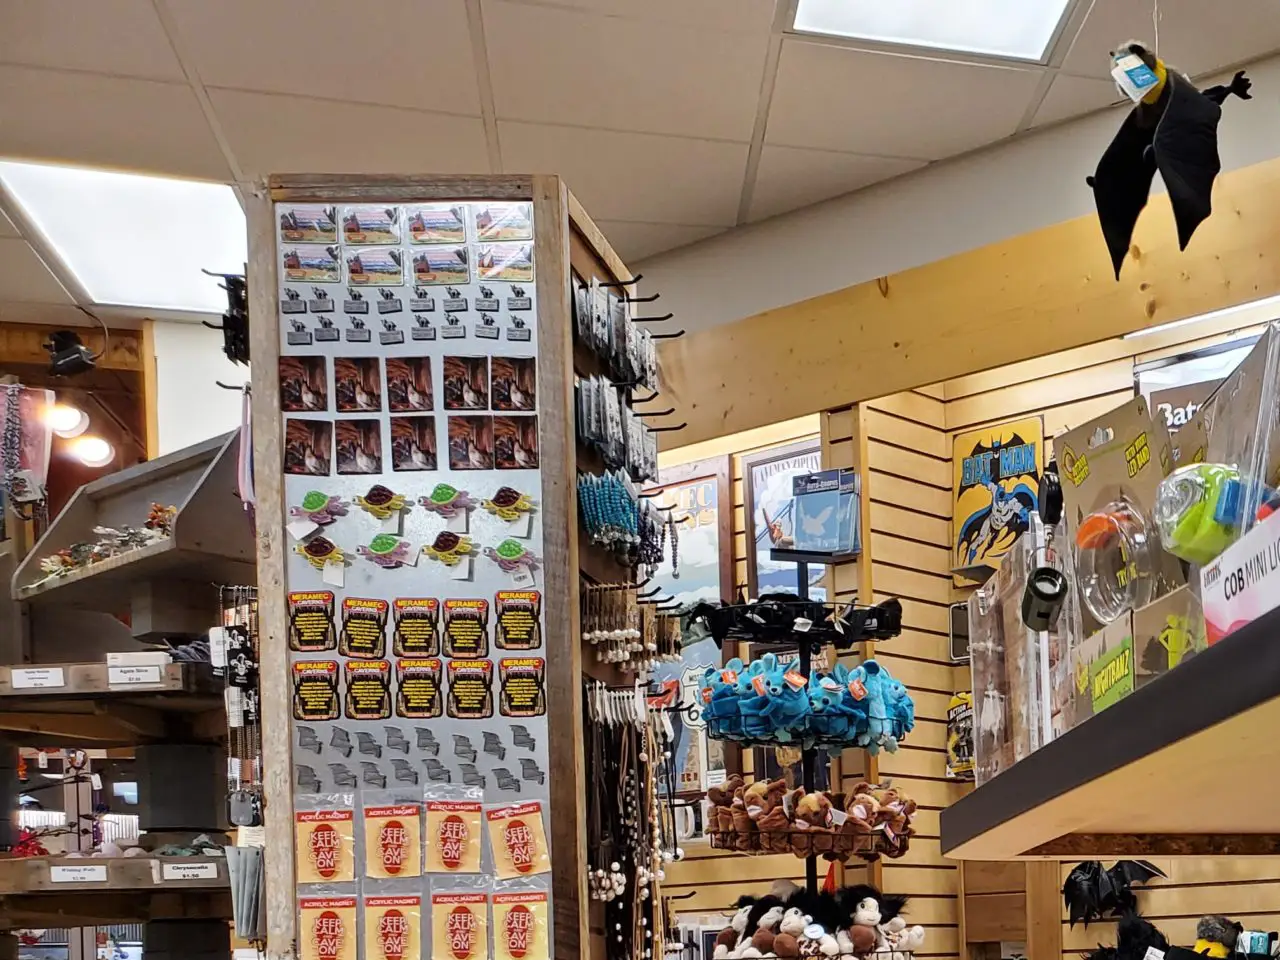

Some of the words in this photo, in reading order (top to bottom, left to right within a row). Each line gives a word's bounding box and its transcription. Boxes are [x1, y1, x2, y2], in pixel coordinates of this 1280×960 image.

[1224, 568, 1245, 601] COB
[1245, 549, 1268, 587] MINI
[347, 600, 383, 608] MERAMEC
[441, 823, 465, 831] KEEP
[310, 831, 336, 840] KEEP
[381, 828, 405, 836] KEEP
[438, 830, 467, 839] CALM
[504, 826, 528, 838] KEEP
[379, 836, 408, 844] CALM
[504, 834, 533, 845] CALM
[308, 839, 339, 849] CALM
[437, 842, 467, 850] CAVE
[310, 850, 339, 860] CAVE
[377, 848, 408, 858] CAVE
[443, 850, 459, 858] ON
[505, 846, 535, 858] CAVE
[318, 859, 333, 867] ON
[384, 856, 401, 864] ON
[513, 856, 530, 864] ON
[506, 912, 531, 920] KEEP
[315, 918, 342, 926] KEEP
[380, 917, 407, 925] KEEP
[504, 920, 533, 928] CALM
[378, 925, 408, 933] CALM
[446, 921, 476, 930] CALM
[313, 926, 344, 936] CALM
[446, 932, 475, 940] CAVE
[503, 932, 532, 940] CAVE
[312, 939, 344, 948] CAVE
[378, 937, 407, 947] CAVE
[453, 941, 468, 949] ON
[510, 940, 525, 948] ON
[320, 946, 336, 954] ON
